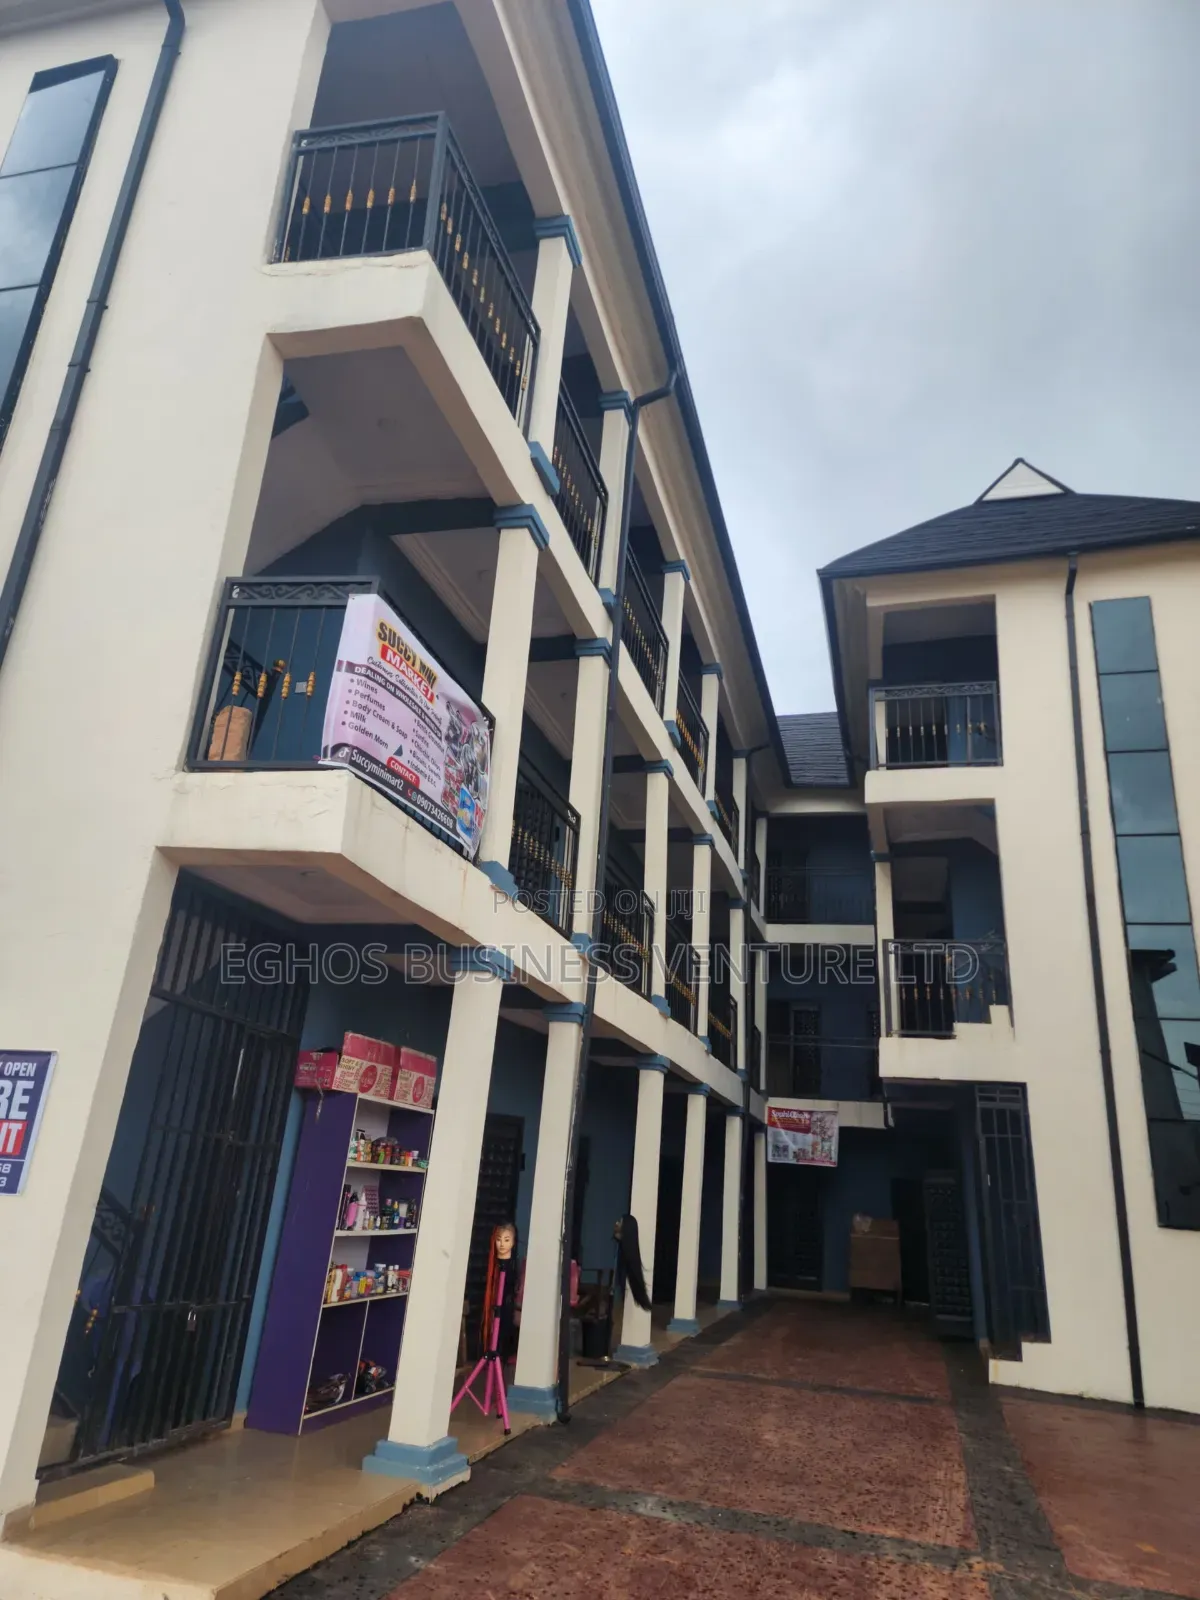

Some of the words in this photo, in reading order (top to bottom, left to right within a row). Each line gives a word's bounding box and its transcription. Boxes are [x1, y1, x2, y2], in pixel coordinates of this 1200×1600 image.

[378, 621, 417, 667] SUCCY
[419, 658, 437, 689] MINI
[356, 678, 378, 694] Wines
[385, 649, 432, 699] MARKET
[354, 666, 386, 686] DEALING
[386, 682, 395, 693] ON
[395, 687, 421, 716] WHOLESALE
[354, 689, 386, 711] Perfumes
[350, 710, 366, 723] Milk
[352, 700, 372, 715] Body
[372, 709, 391, 727] Cream
[391, 721, 396, 730] &
[396, 726, 408, 739] Soap
[348, 721, 374, 740] Golden
[351, 749, 404, 791] Succyminimart2
[390, 759, 417, 785] CONTACT:
[4, 1062, 37, 1077] OPEN
